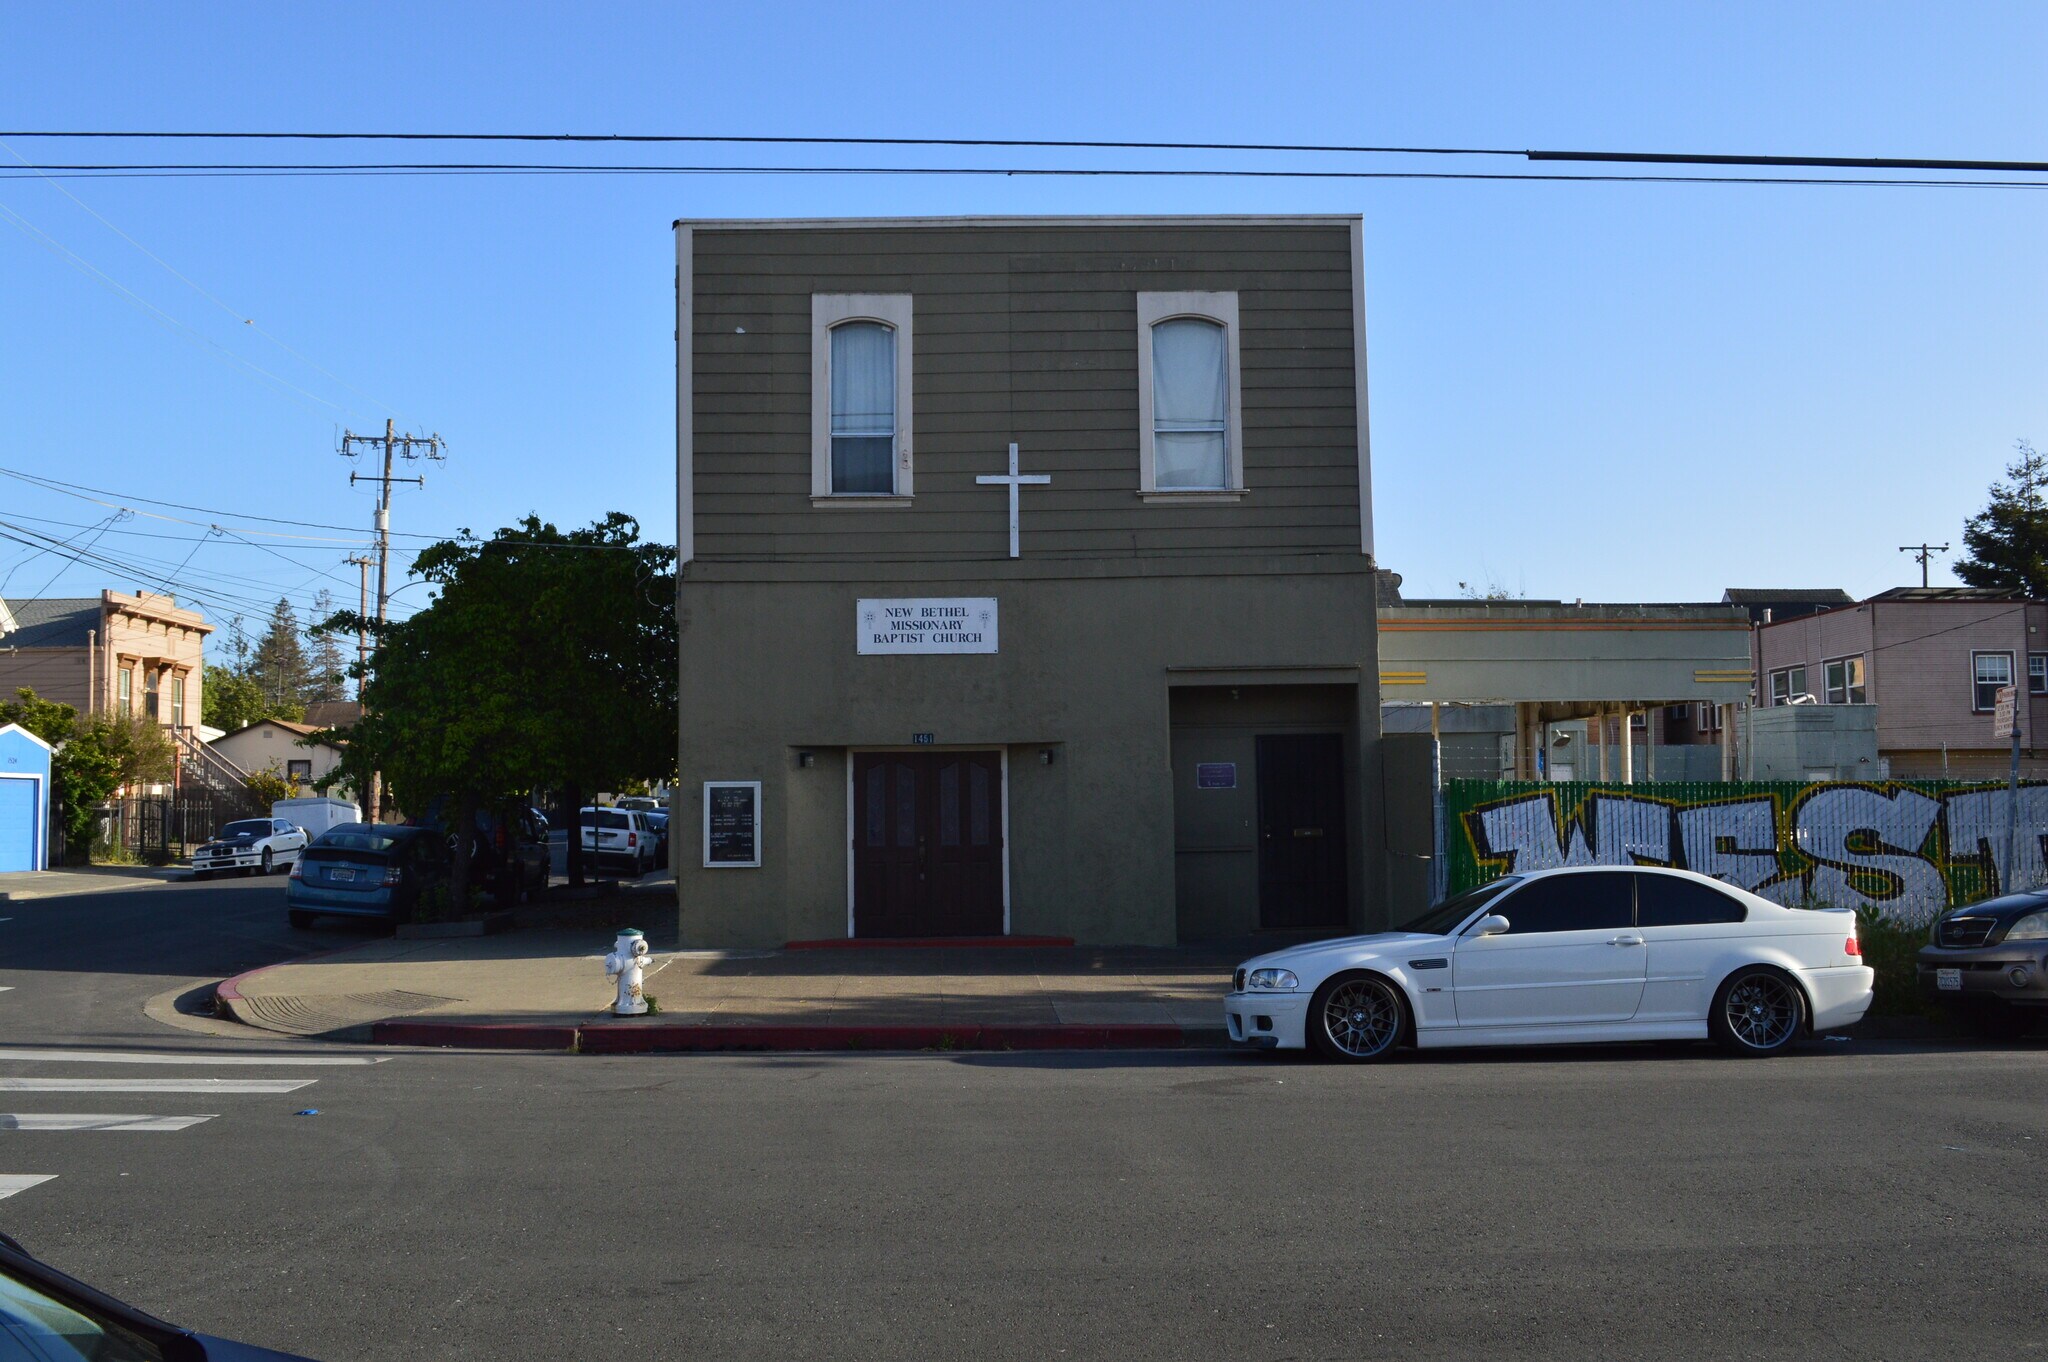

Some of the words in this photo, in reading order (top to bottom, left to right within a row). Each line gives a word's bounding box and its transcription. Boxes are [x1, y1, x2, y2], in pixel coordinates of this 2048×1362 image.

[885, 607, 913, 618] NEW
[921, 607, 969, 617] BETHEL
[891, 620, 964, 631] MISSIONARY
[873, 633, 925, 644] BAPTIST
[932, 632, 982, 643] CHURCH
